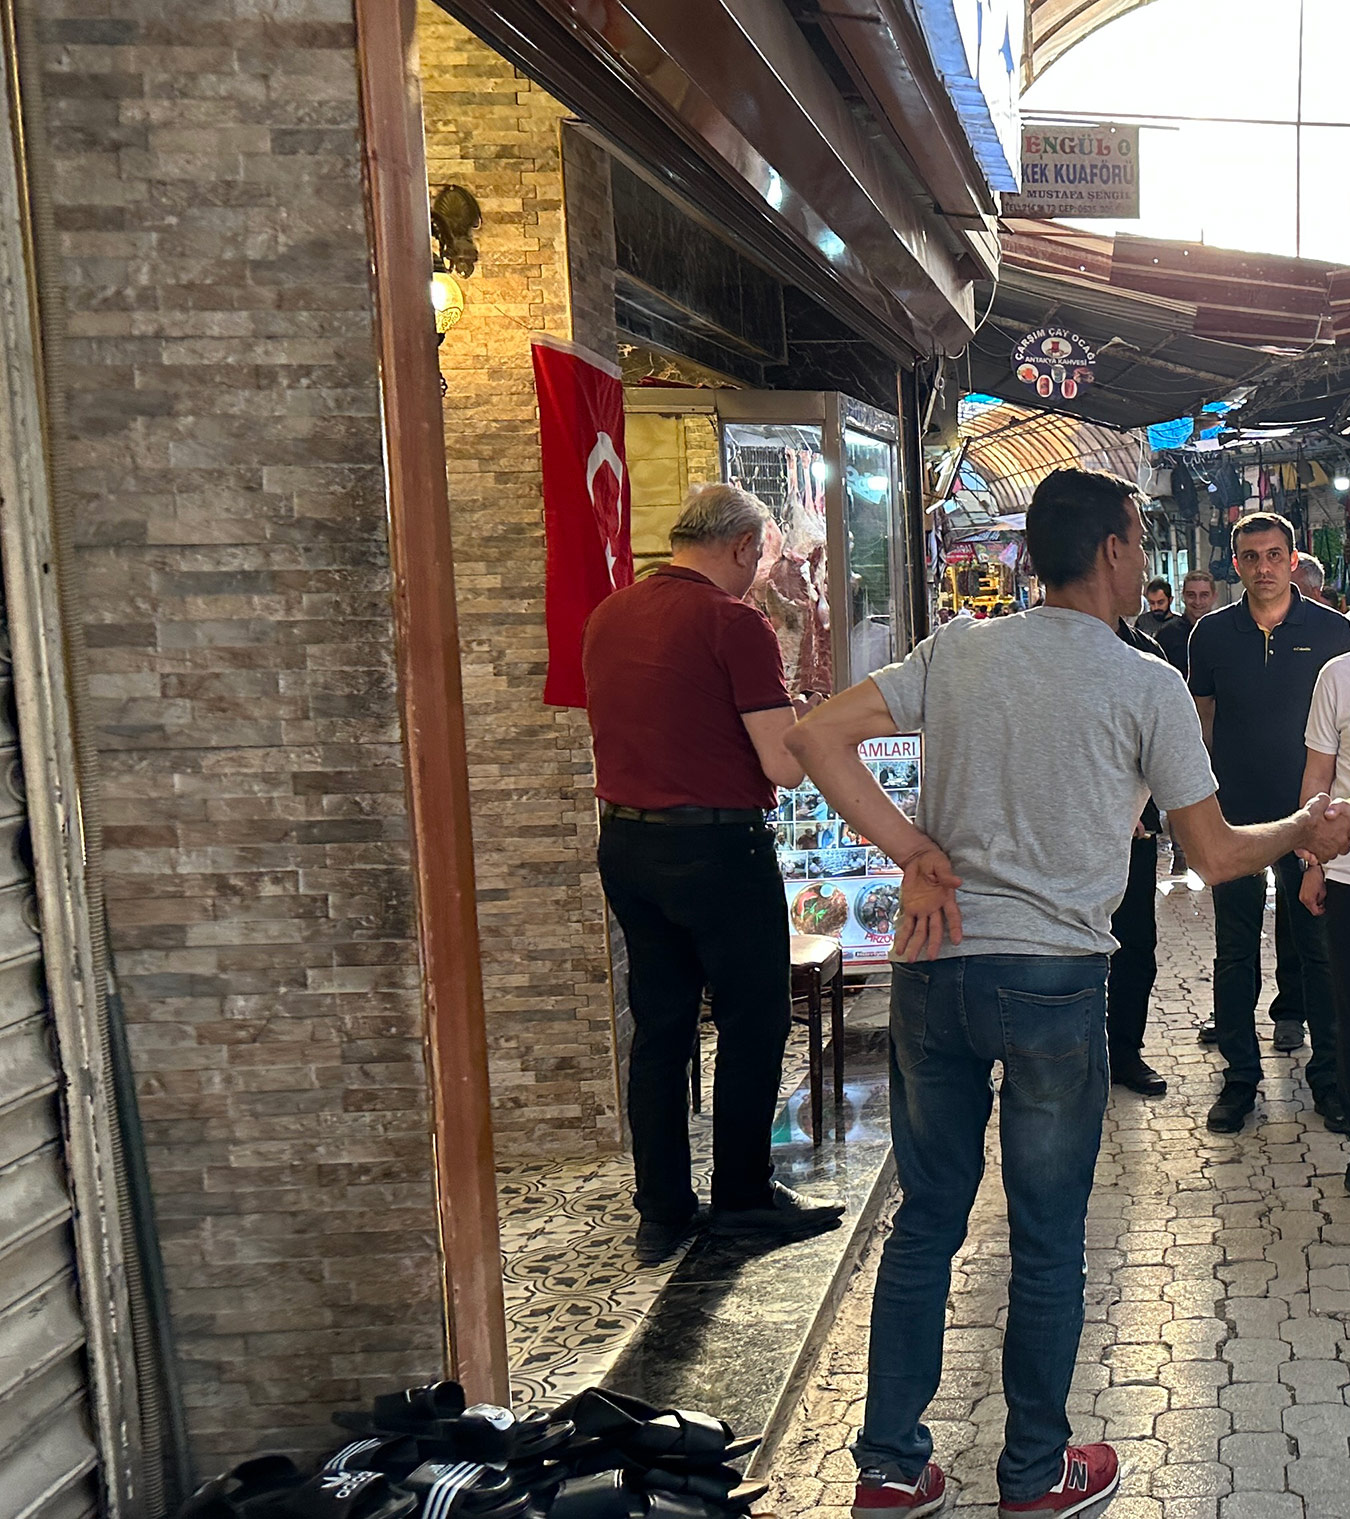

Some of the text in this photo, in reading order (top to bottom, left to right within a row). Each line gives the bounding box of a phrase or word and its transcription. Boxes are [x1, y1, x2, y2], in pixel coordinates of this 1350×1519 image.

[1025, 134, 1111, 156] ENGÜL
[1022, 160, 1135, 184] KEK KUAFÖRÜ
[1027, 190, 1084, 199] MUSTAFA
[1015, 328, 1096, 364] ÇARŞIM ÇAY OCAĞI
[860, 742, 915, 757] AMLARI
[1068, 1459, 1088, 1492] N
